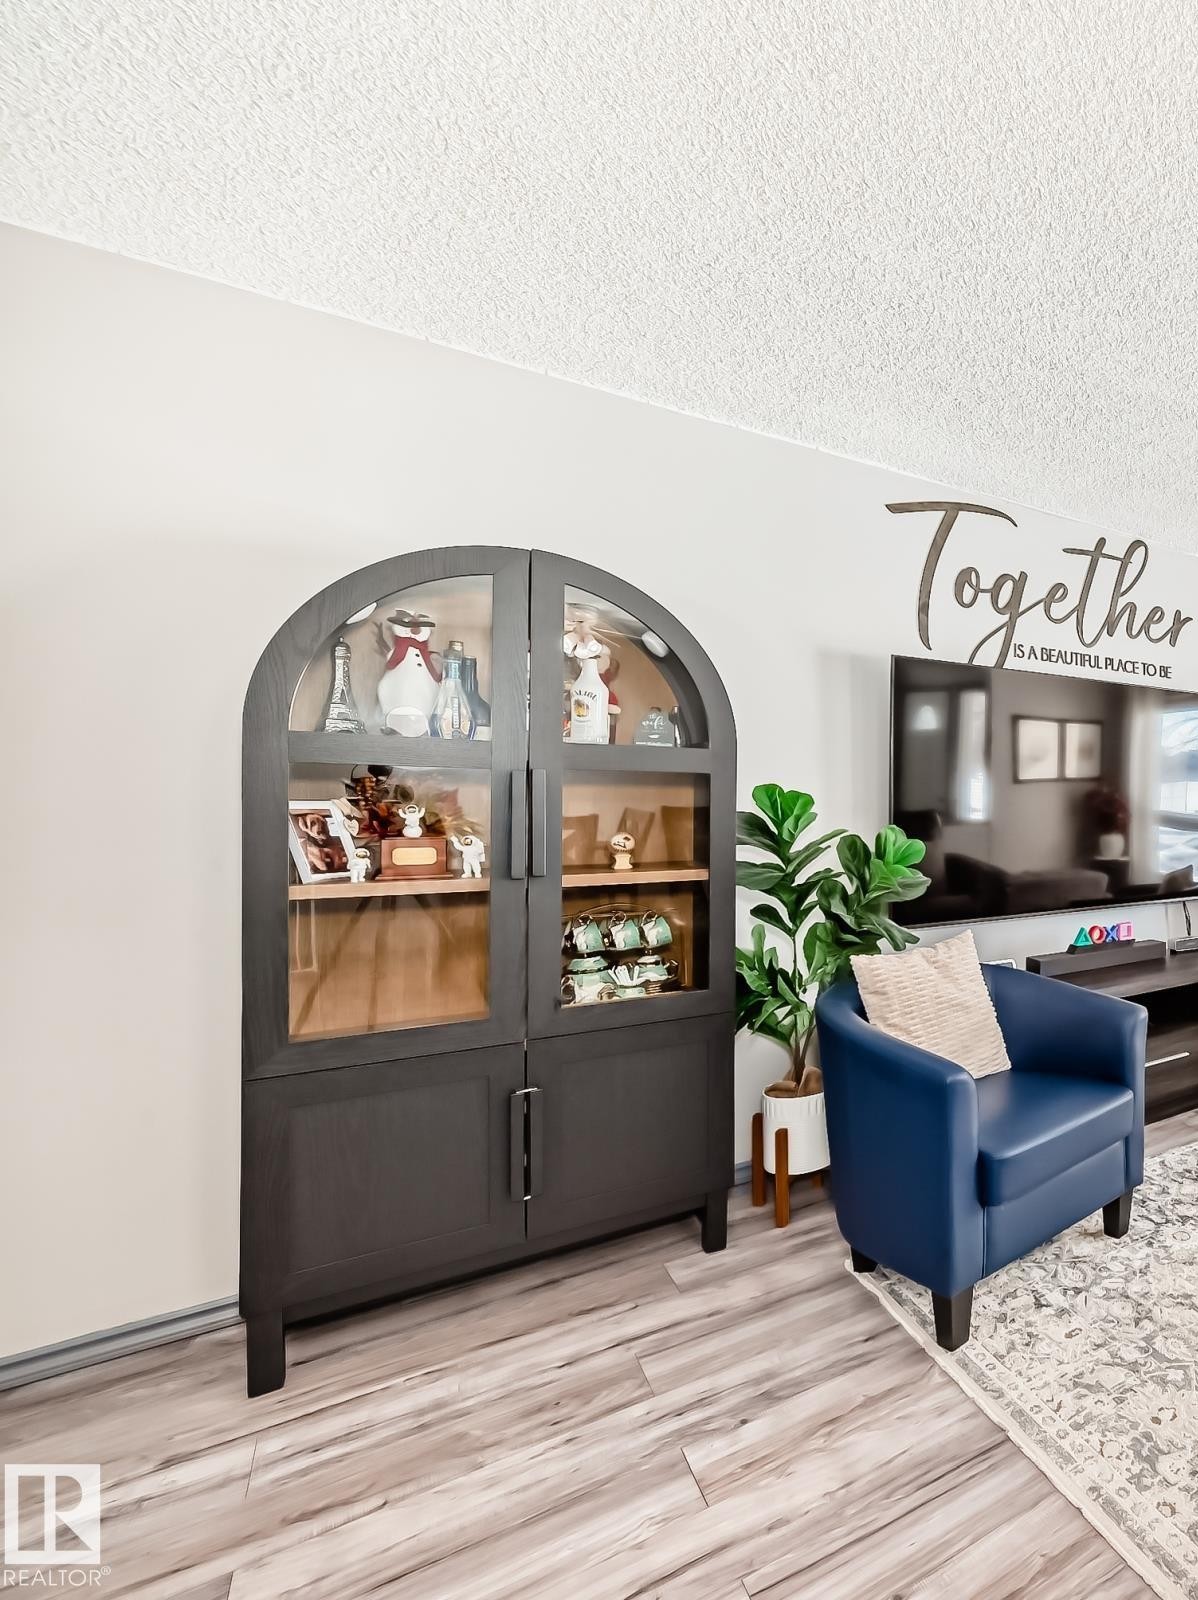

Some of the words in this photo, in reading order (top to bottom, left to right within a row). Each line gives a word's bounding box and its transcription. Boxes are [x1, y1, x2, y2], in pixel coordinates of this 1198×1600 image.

[885, 501, 1193, 668] Together
[1013, 643, 1025, 658] IS
[1027, 645, 1039, 660] A
[1040, 647, 1102, 669] BEAUTIFUL
[1104, 656, 1140, 675] PLACE
[1141, 662, 1157, 677] TO
[1159, 665, 1173, 679] BE
